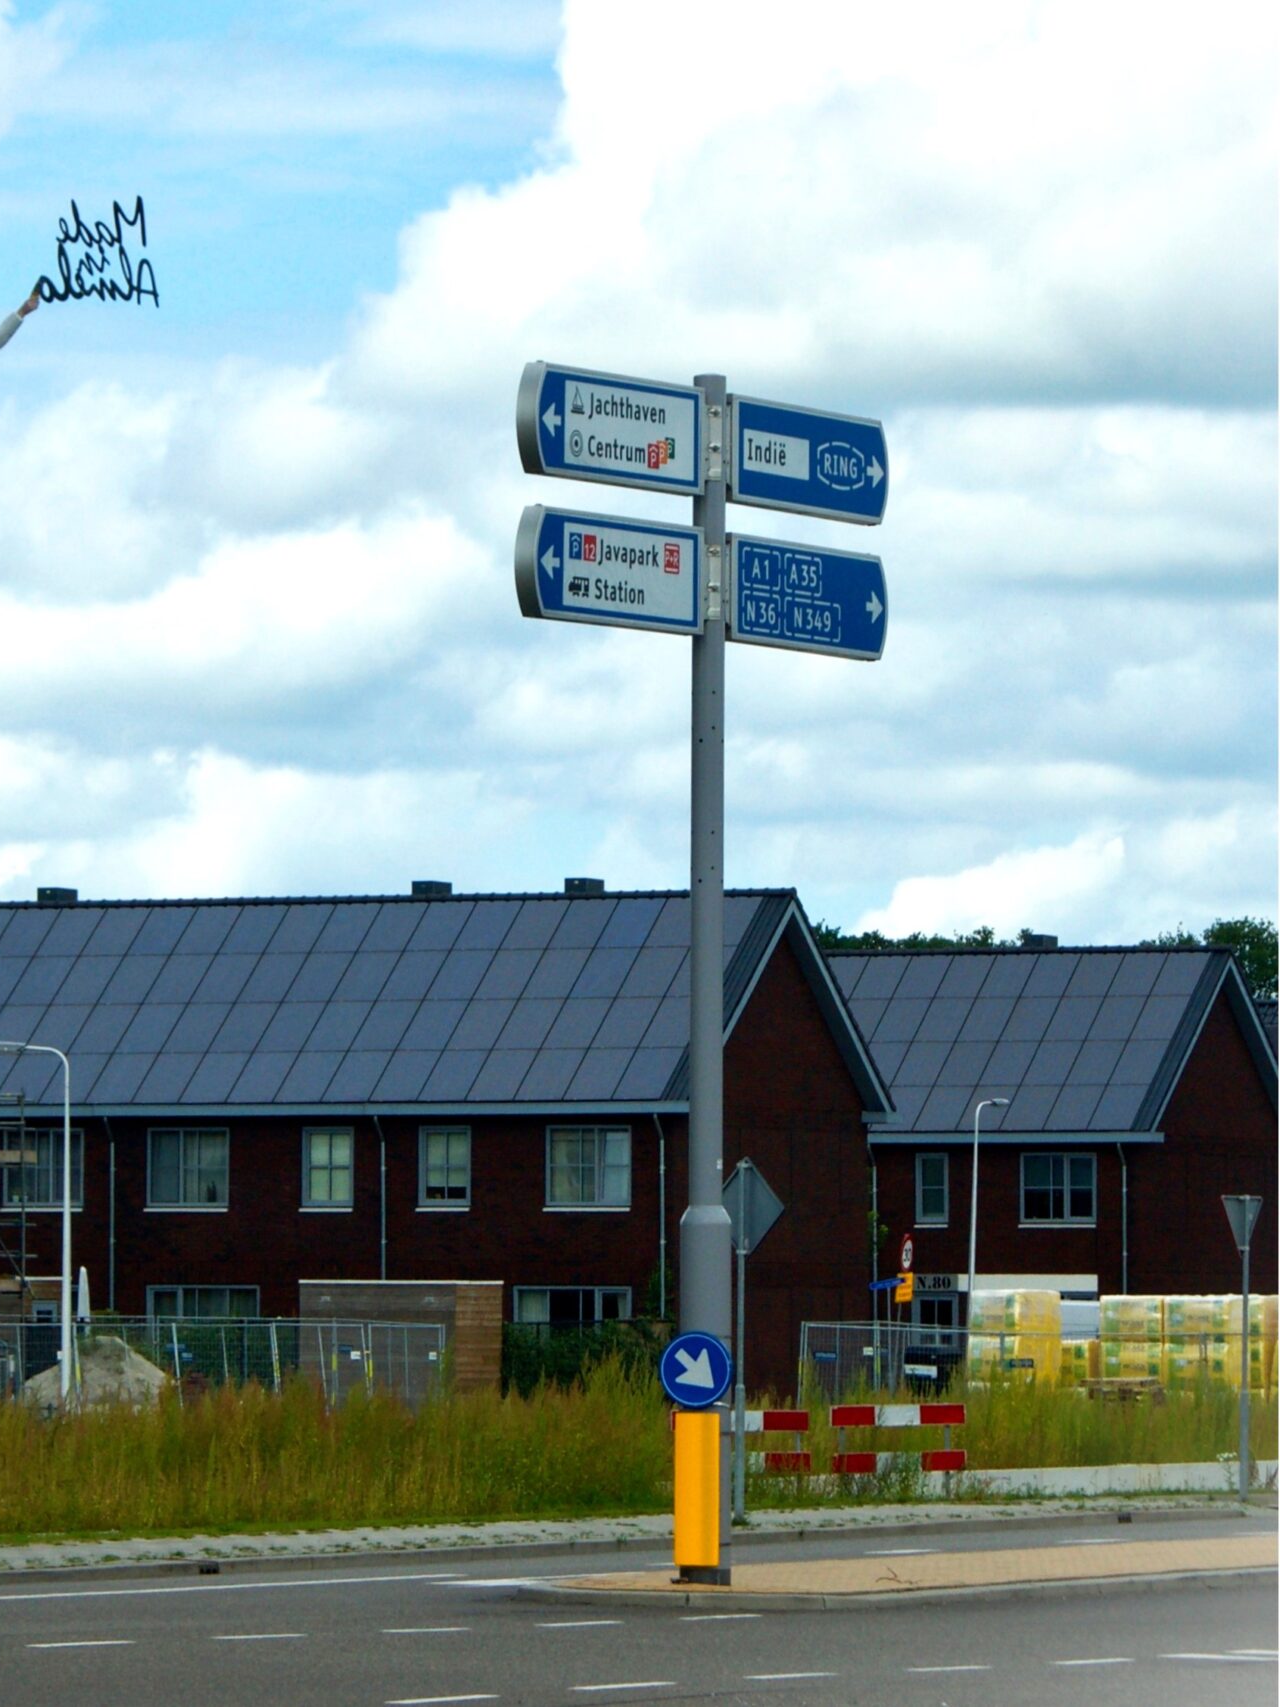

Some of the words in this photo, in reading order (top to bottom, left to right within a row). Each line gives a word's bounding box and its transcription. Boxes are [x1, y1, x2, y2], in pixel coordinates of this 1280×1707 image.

[588, 392, 666, 424] Jachthaven
[588, 435, 646, 464] Centrum
[747, 438, 786, 466] Indië
[823, 453, 858, 479] RING
[584, 546, 596, 561] 12
[598, 539, 659, 569] Javapark
[664, 551, 679, 566] P+R
[751, 557, 770, 580] A1
[789, 563, 817, 587] A35
[594, 578, 645, 605] Station
[746, 600, 776, 625] N36
[793, 607, 832, 633] N349
[917, 1275, 952, 1290] N.80
